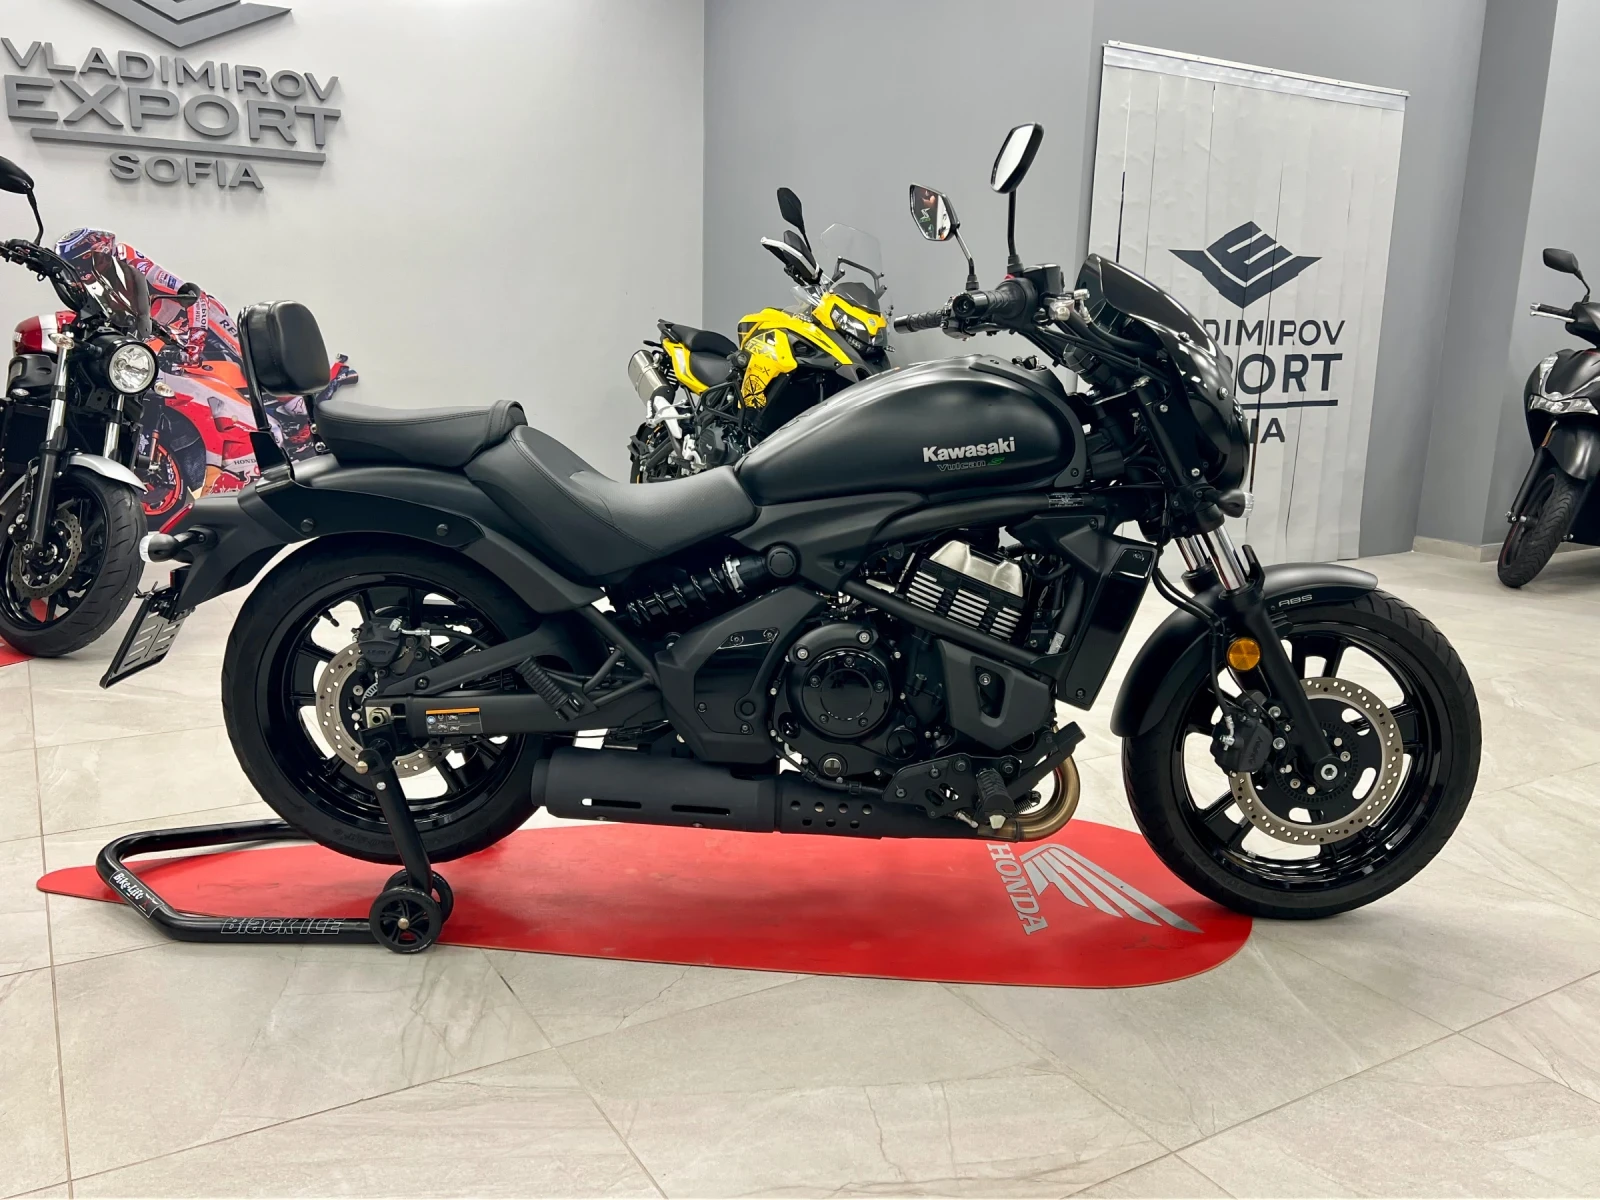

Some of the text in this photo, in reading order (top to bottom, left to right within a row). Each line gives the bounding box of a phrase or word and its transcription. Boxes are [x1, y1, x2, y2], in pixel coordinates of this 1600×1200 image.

[1, 37, 339, 101] VLADIMIROV
[3, 74, 342, 147] EXPORT
[109, 152, 265, 190] SOFIA
[1203, 319, 1345, 346] DIMIROV
[1224, 353, 1343, 394] ORT
[233, 458, 257, 466] HOND
[922, 436, 1016, 463] Kawasaki
[937, 460, 986, 472] Vulcan
[1278, 594, 1313, 608] ABS
[986, 843, 1048, 935] HONDA
